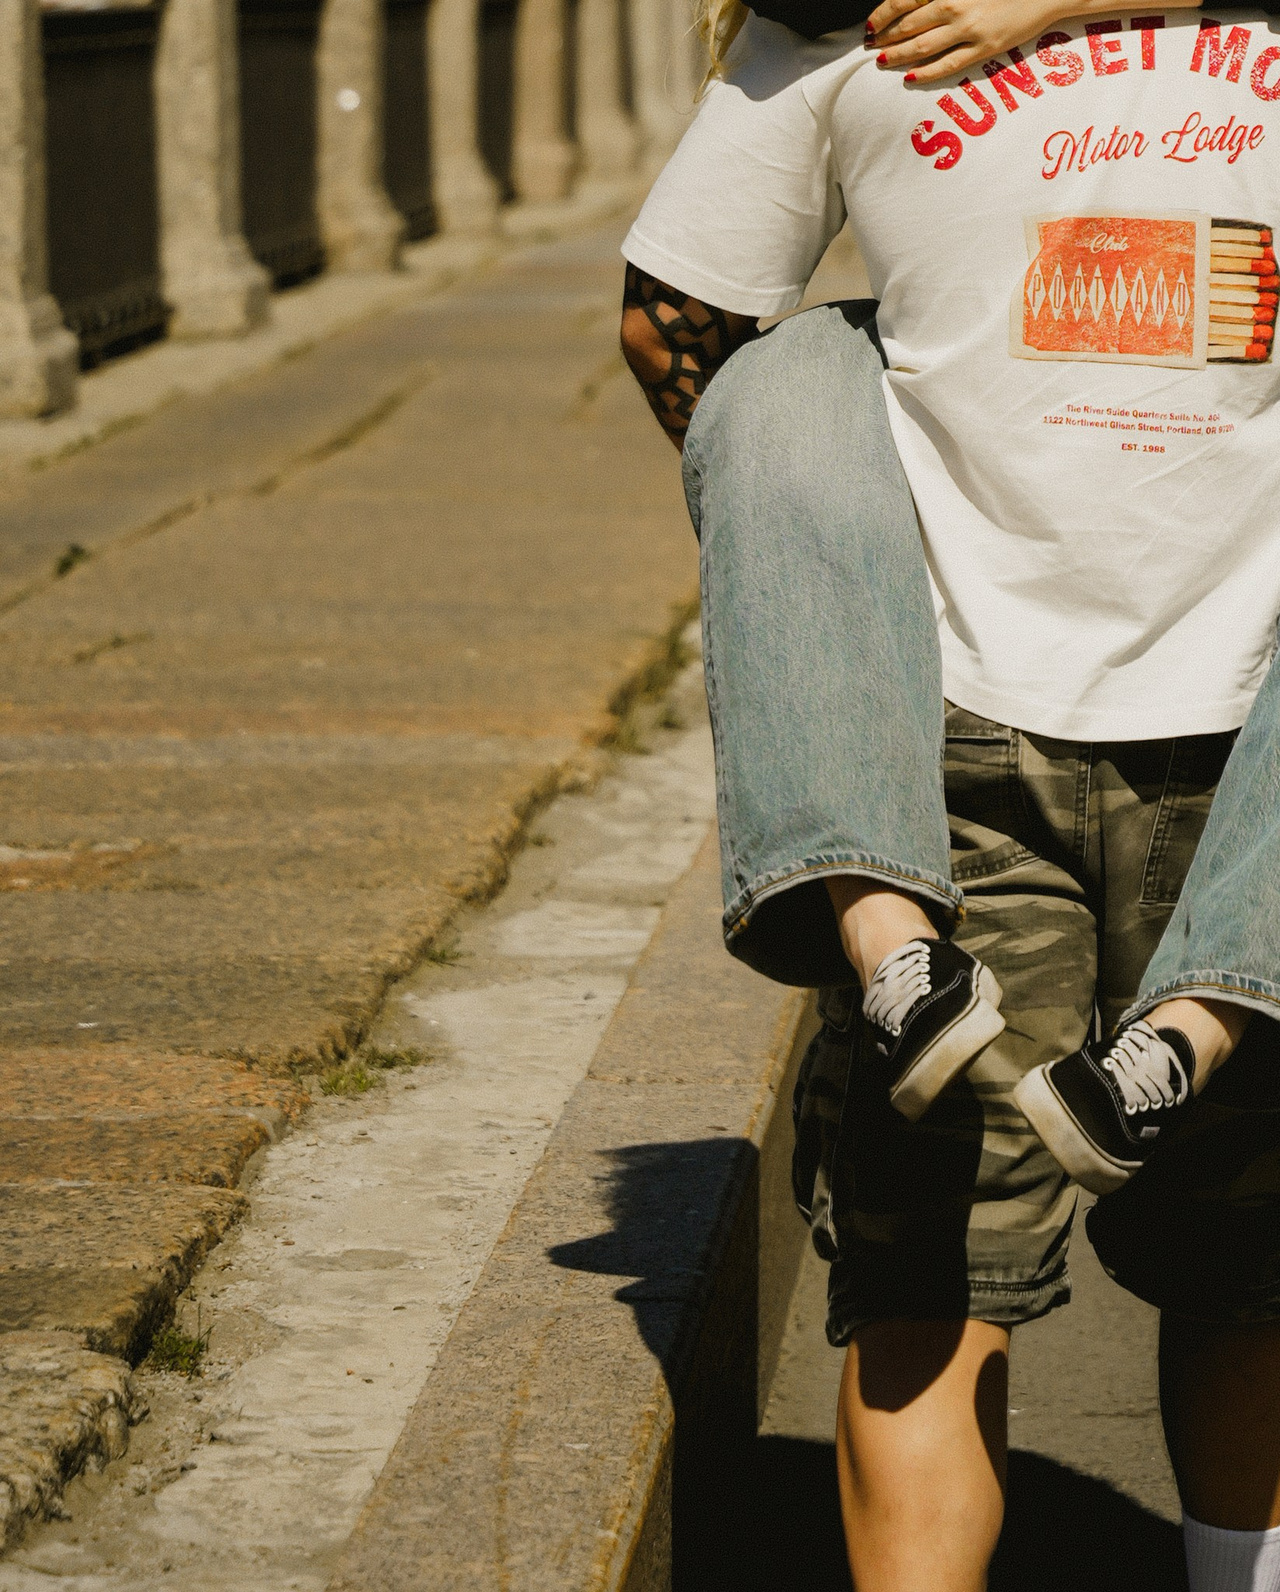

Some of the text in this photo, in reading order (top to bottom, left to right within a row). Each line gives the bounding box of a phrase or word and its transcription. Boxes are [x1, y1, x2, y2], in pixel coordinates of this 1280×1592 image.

[911, 15, 1165, 171] SUNSET
[1041, 111, 1266, 180] Motor Lodge
[1090, 233, 1130, 254] Club
[1032, 273, 1186, 317] PORTLAND
[1066, 404, 1082, 413] The
[1083, 405, 1104, 415] River
[1132, 409, 1168, 420] Quarters
[1065, 417, 1108, 428] Northwest
[1205, 426, 1217, 435] OR
[1121, 443, 1140, 451] EST.
